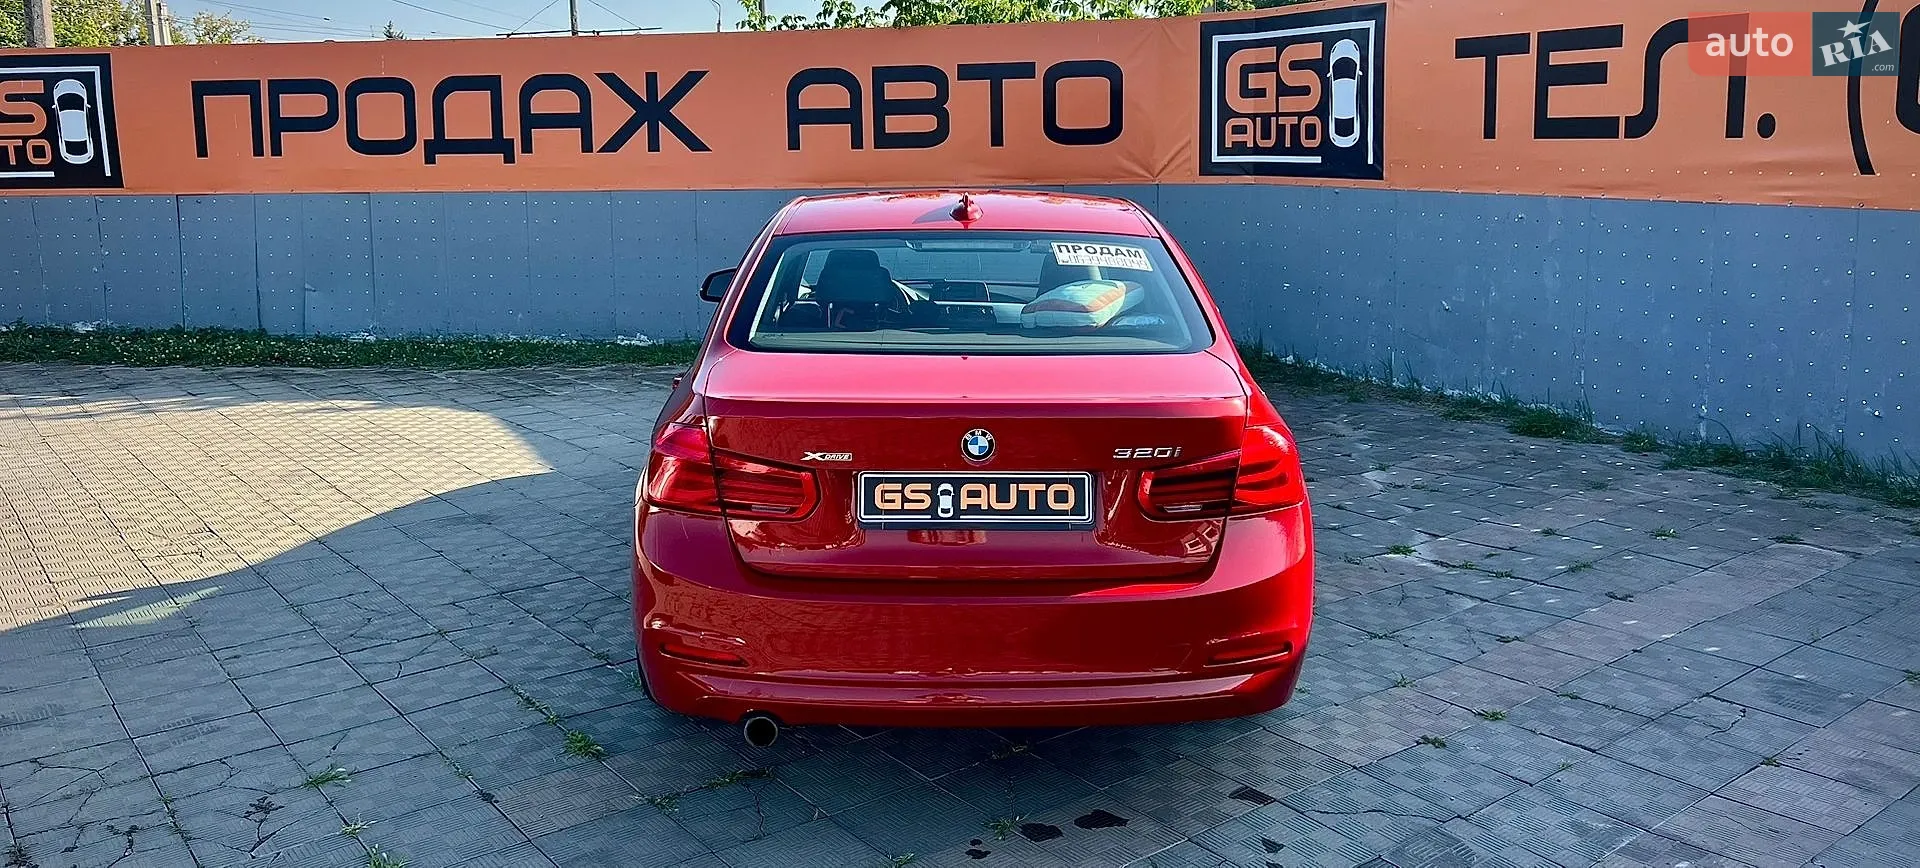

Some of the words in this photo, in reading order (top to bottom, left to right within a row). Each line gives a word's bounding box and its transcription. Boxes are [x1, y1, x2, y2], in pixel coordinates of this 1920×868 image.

[1225, 41, 1323, 114] GS
[1454, 12, 1777, 140] ТЕЛ.
[191, 70, 712, 165] ПРОДАЖ
[786, 60, 1124, 151] АВТО
[1224, 115, 1322, 148] AUTO
[1056, 244, 1143, 259] ПРОДАМ
[965, 429, 993, 441] BMW
[1112, 446, 1182, 459] 320i
[874, 483, 932, 510] GS
[960, 483, 1076, 511] AUTO
